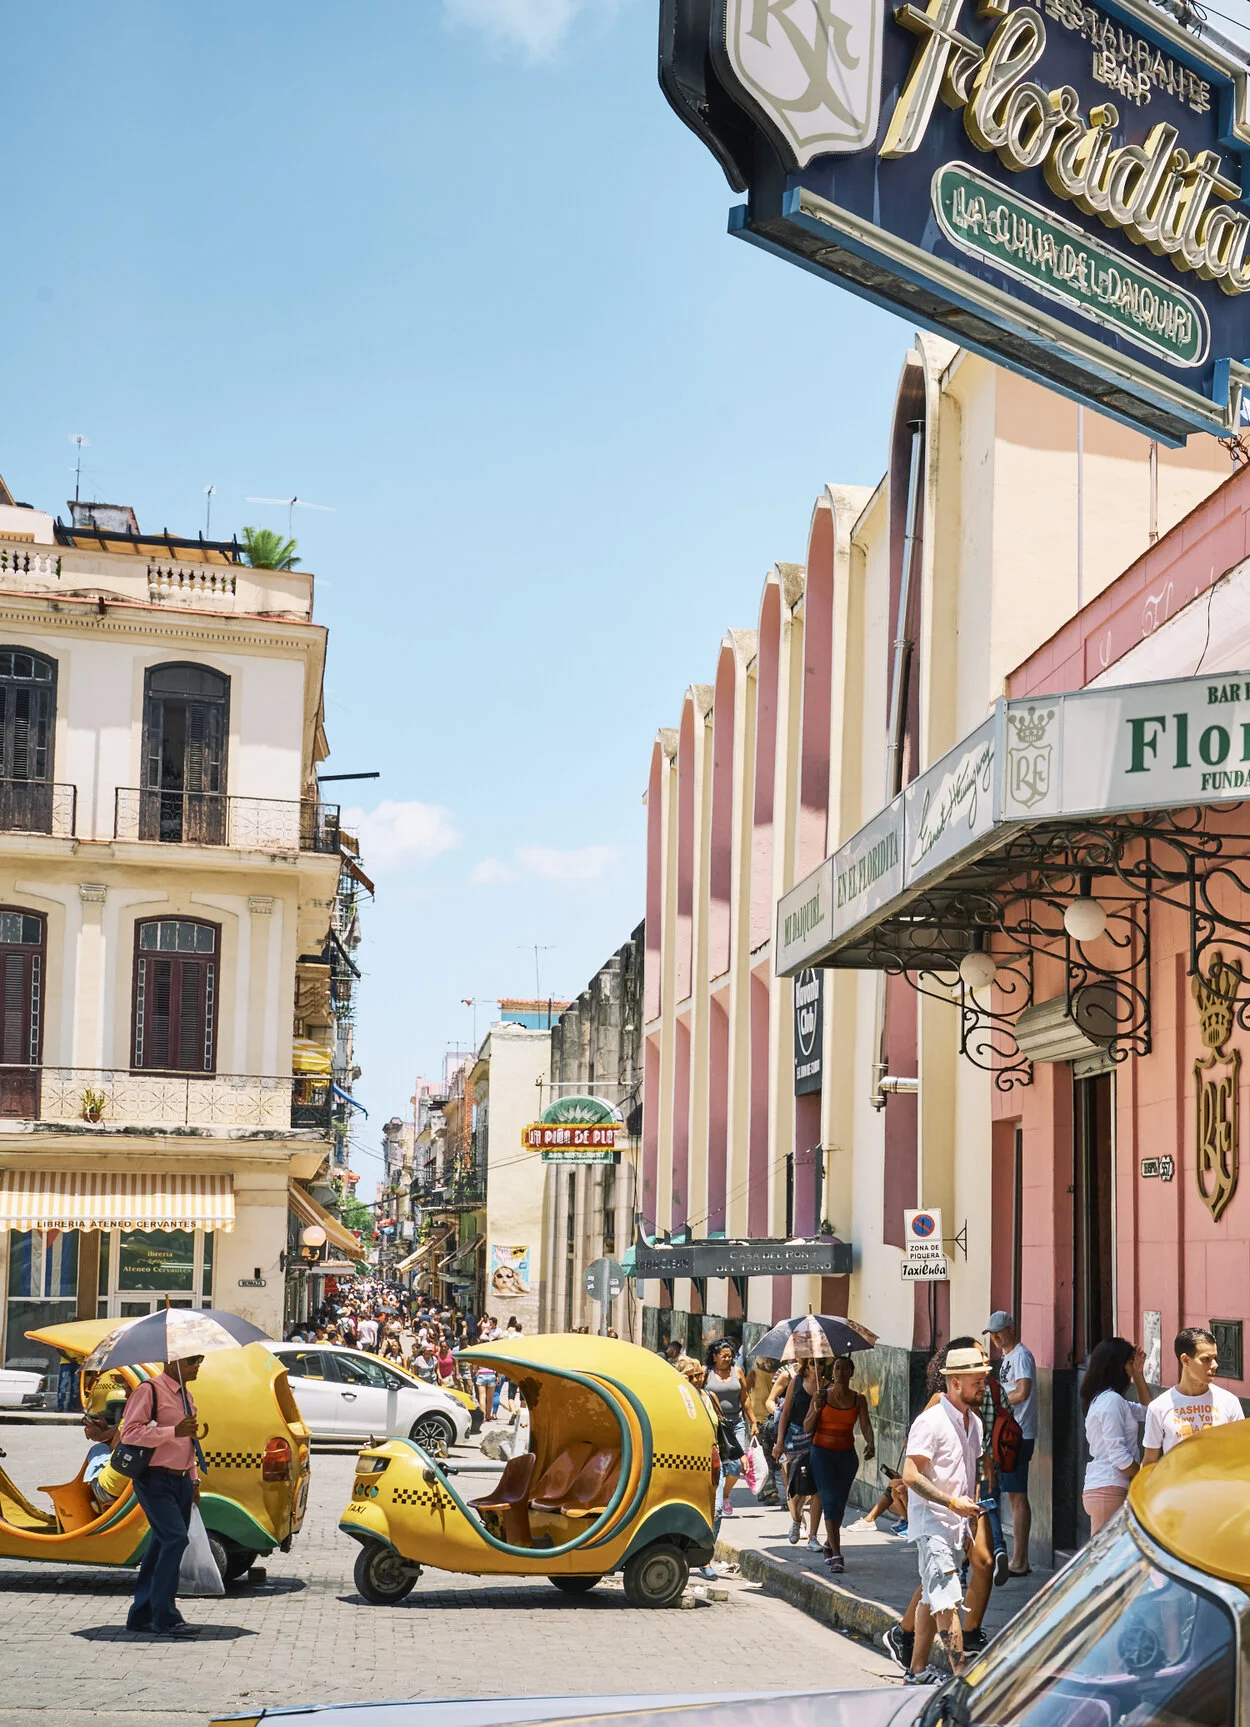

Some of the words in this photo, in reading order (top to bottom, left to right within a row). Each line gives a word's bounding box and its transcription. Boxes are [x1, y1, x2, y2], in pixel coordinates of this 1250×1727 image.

[1093, 51, 1151, 106] BAR
[952, 186, 987, 236] LA
[983, 205, 1055, 272] CUNA
[1052, 244, 1101, 297] DEL
[1207, 682, 1241, 705] BAR
[837, 871, 847, 909] EN
[848, 865, 857, 902] EL
[858, 828, 899, 895] FLORIDITA
[784, 913, 792, 947] MI
[574, 1129, 589, 1144] DE
[90, 1220, 132, 1229] ATENEO
[136, 1220, 197, 1229] CERVANTES
[902, 1263, 946, 1276] TaxiCuba
[1174, 1404, 1219, 1416] FASHION
[354, 1482, 379, 1498] COCO
[347, 1503, 366, 1513] TAXI
